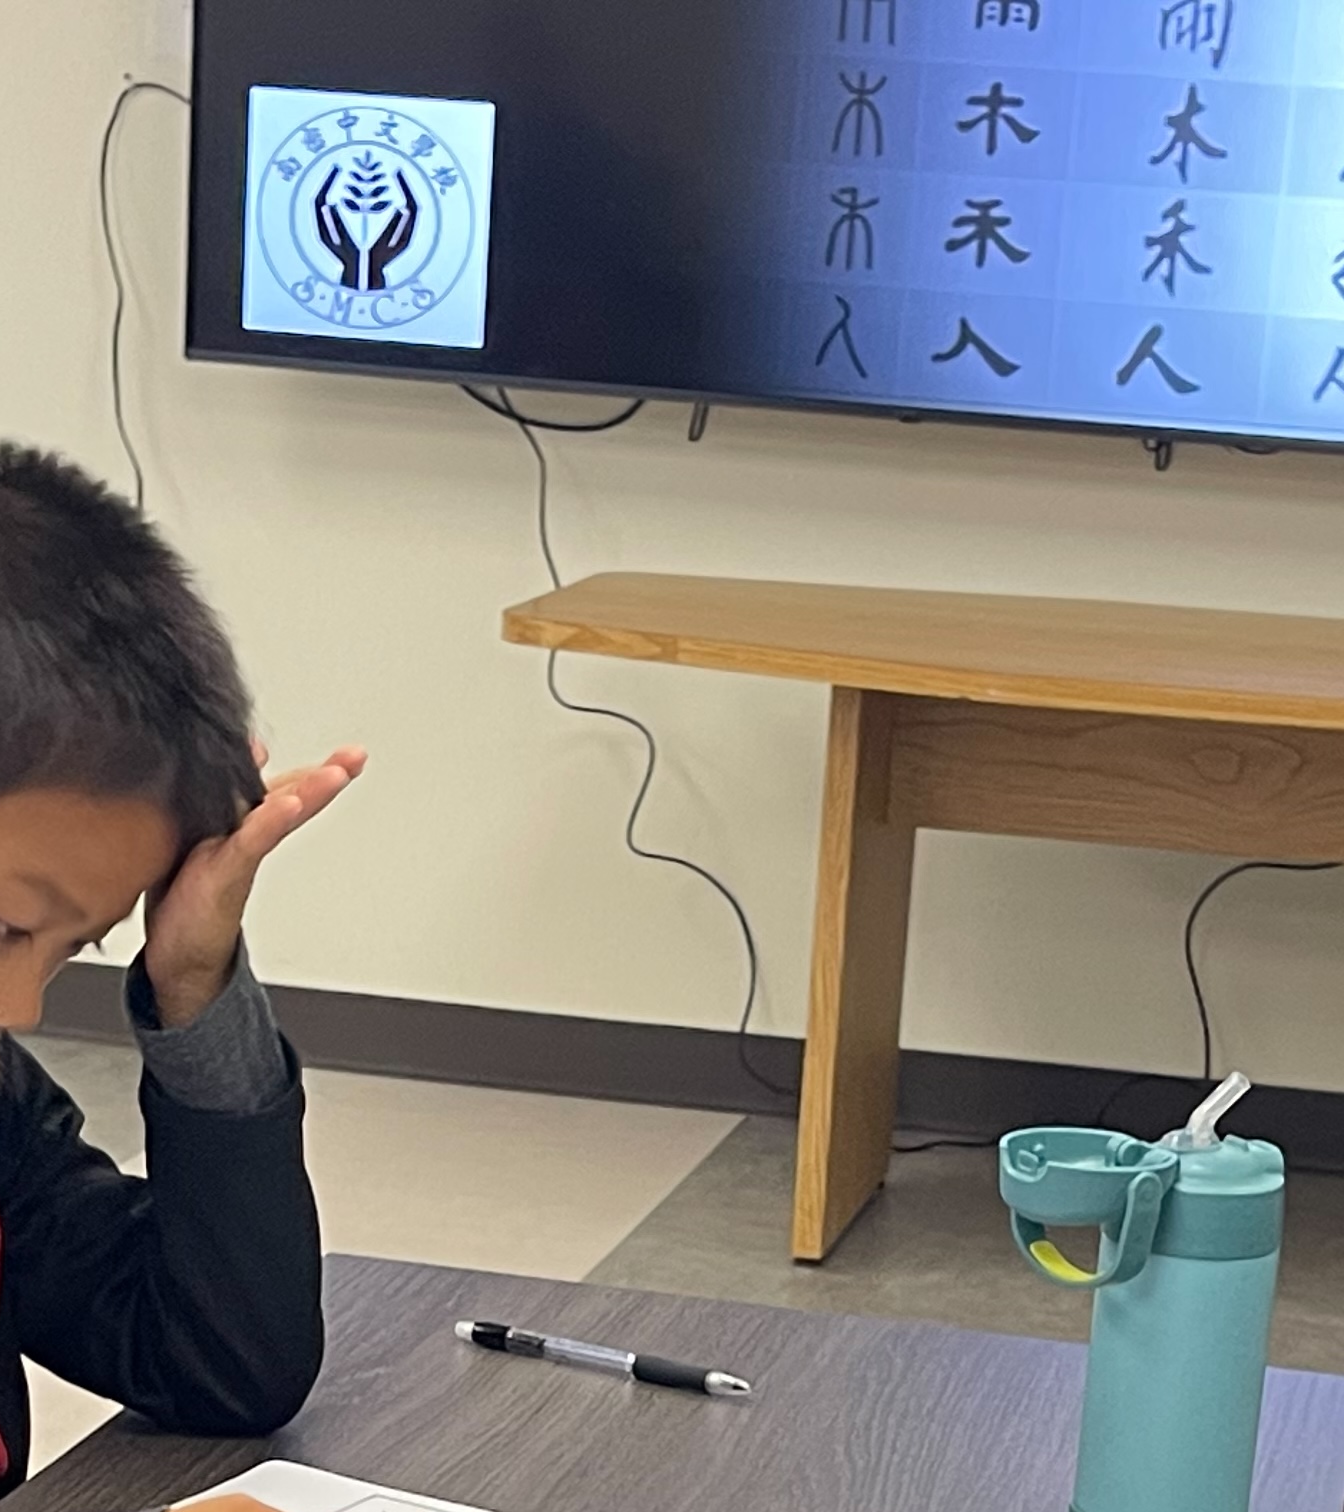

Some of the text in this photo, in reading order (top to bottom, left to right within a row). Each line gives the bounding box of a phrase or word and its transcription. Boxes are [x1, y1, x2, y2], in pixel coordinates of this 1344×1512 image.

[956, 82, 1040, 155] 木
[1149, 83, 1228, 184] 木
[944, 200, 1031, 268] 禾
[1142, 199, 1213, 296] 禾
[1117, 325, 1201, 393] 人
